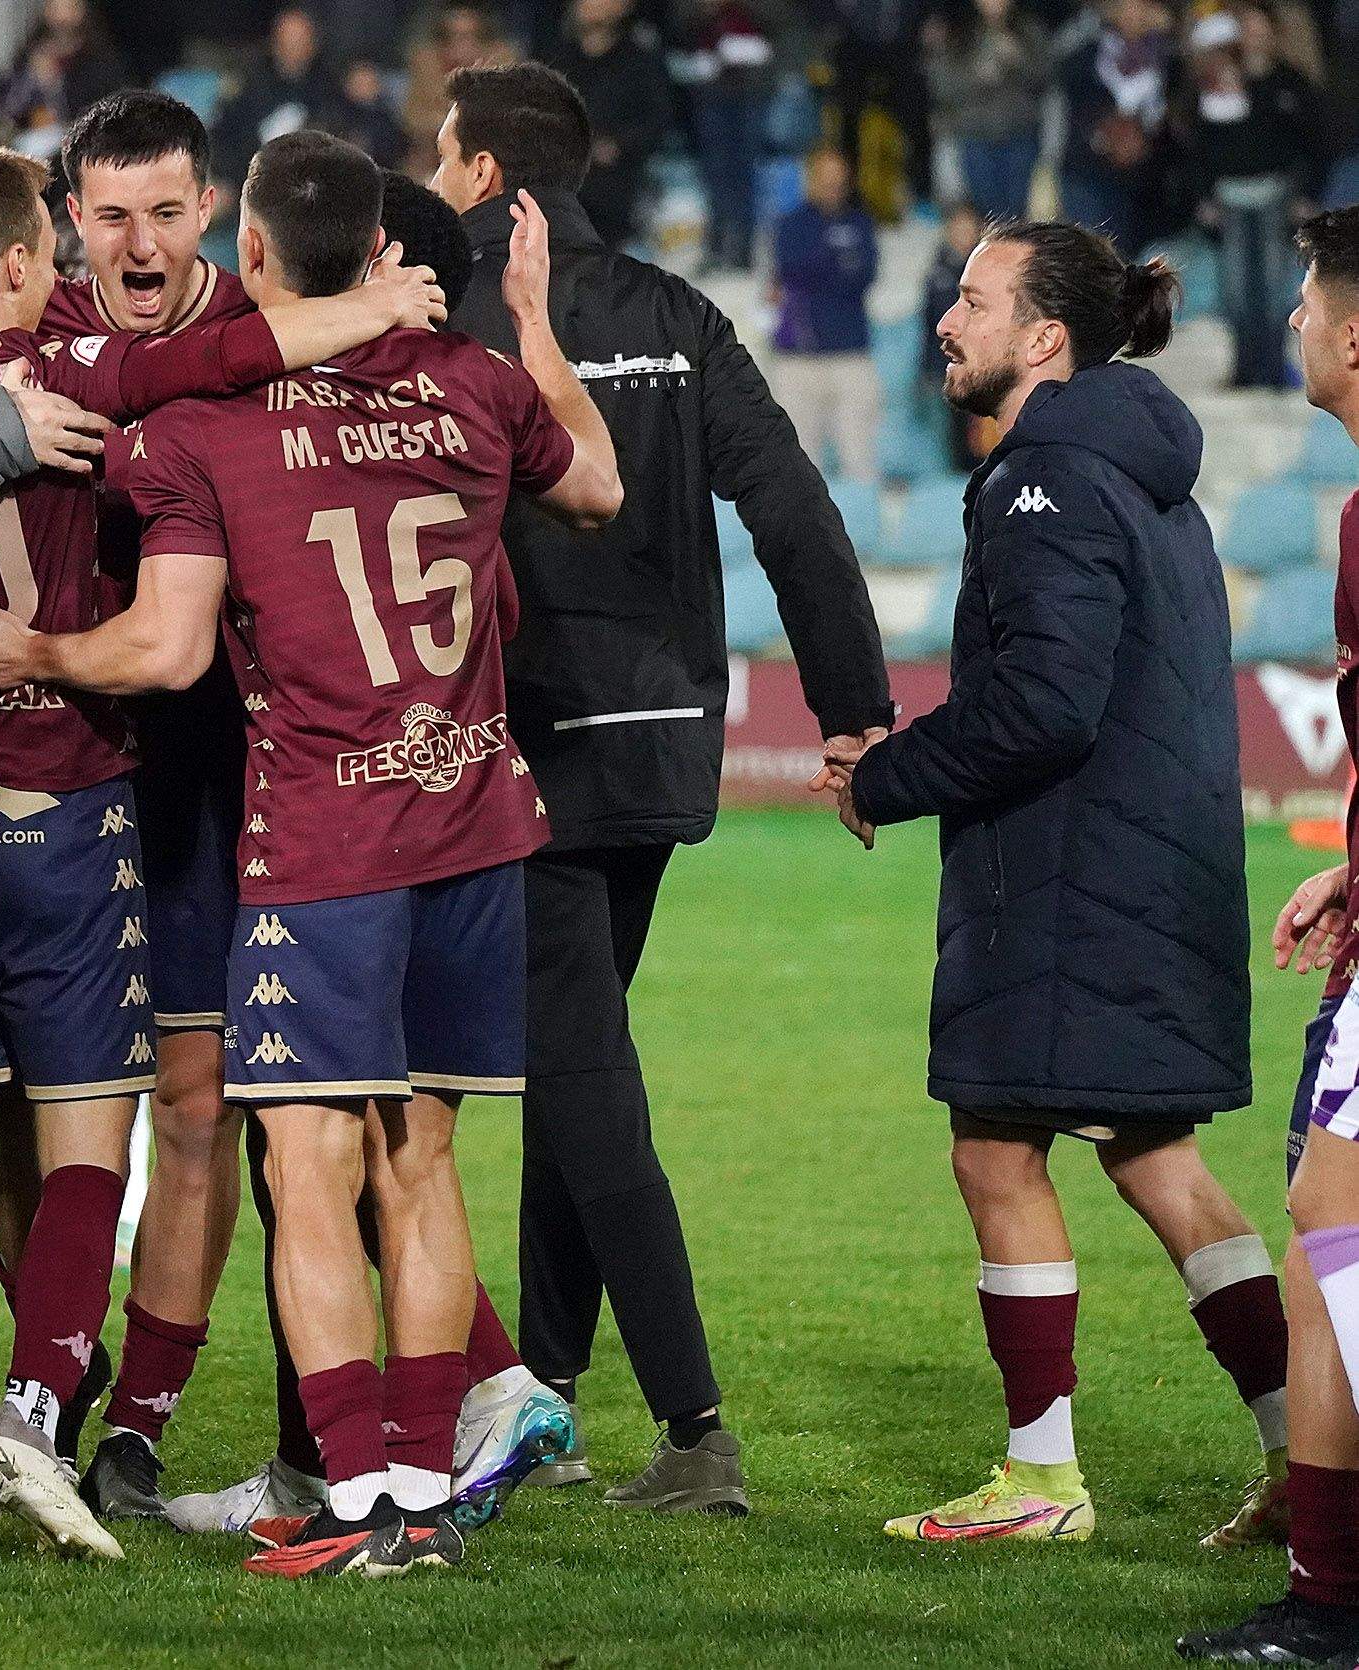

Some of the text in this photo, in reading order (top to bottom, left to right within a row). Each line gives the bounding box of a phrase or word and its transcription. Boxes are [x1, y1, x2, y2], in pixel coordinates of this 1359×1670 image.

[281, 413, 469, 471] M. CUESTA
[306, 493, 474, 688] 15
